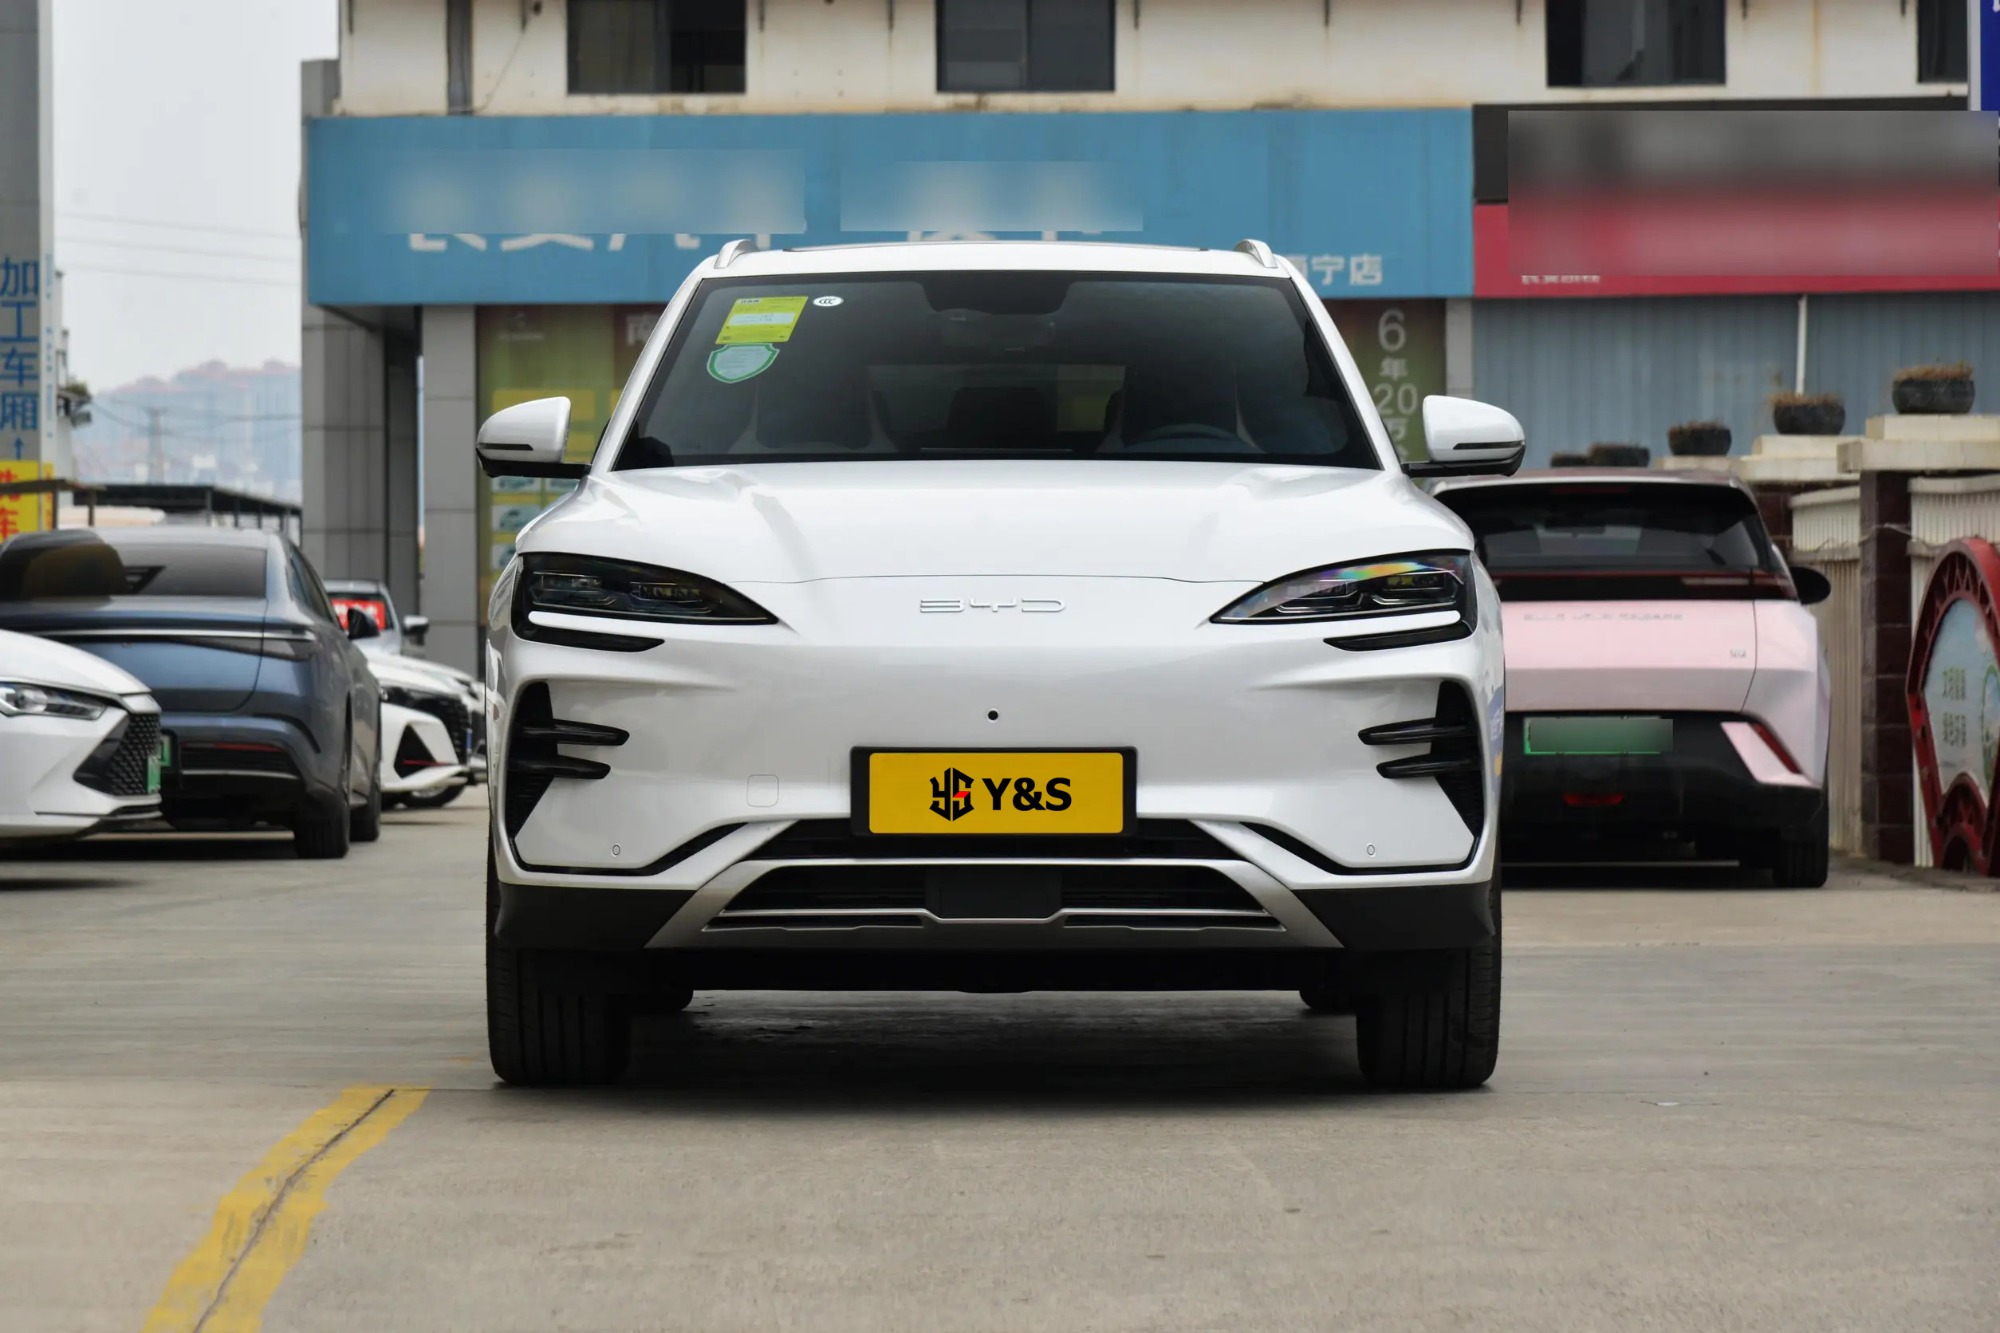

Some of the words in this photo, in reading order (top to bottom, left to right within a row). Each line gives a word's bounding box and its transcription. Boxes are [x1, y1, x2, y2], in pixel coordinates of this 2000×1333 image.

[0, 257, 39, 431] 加工车厢
[920, 598, 1066, 613] BYD
